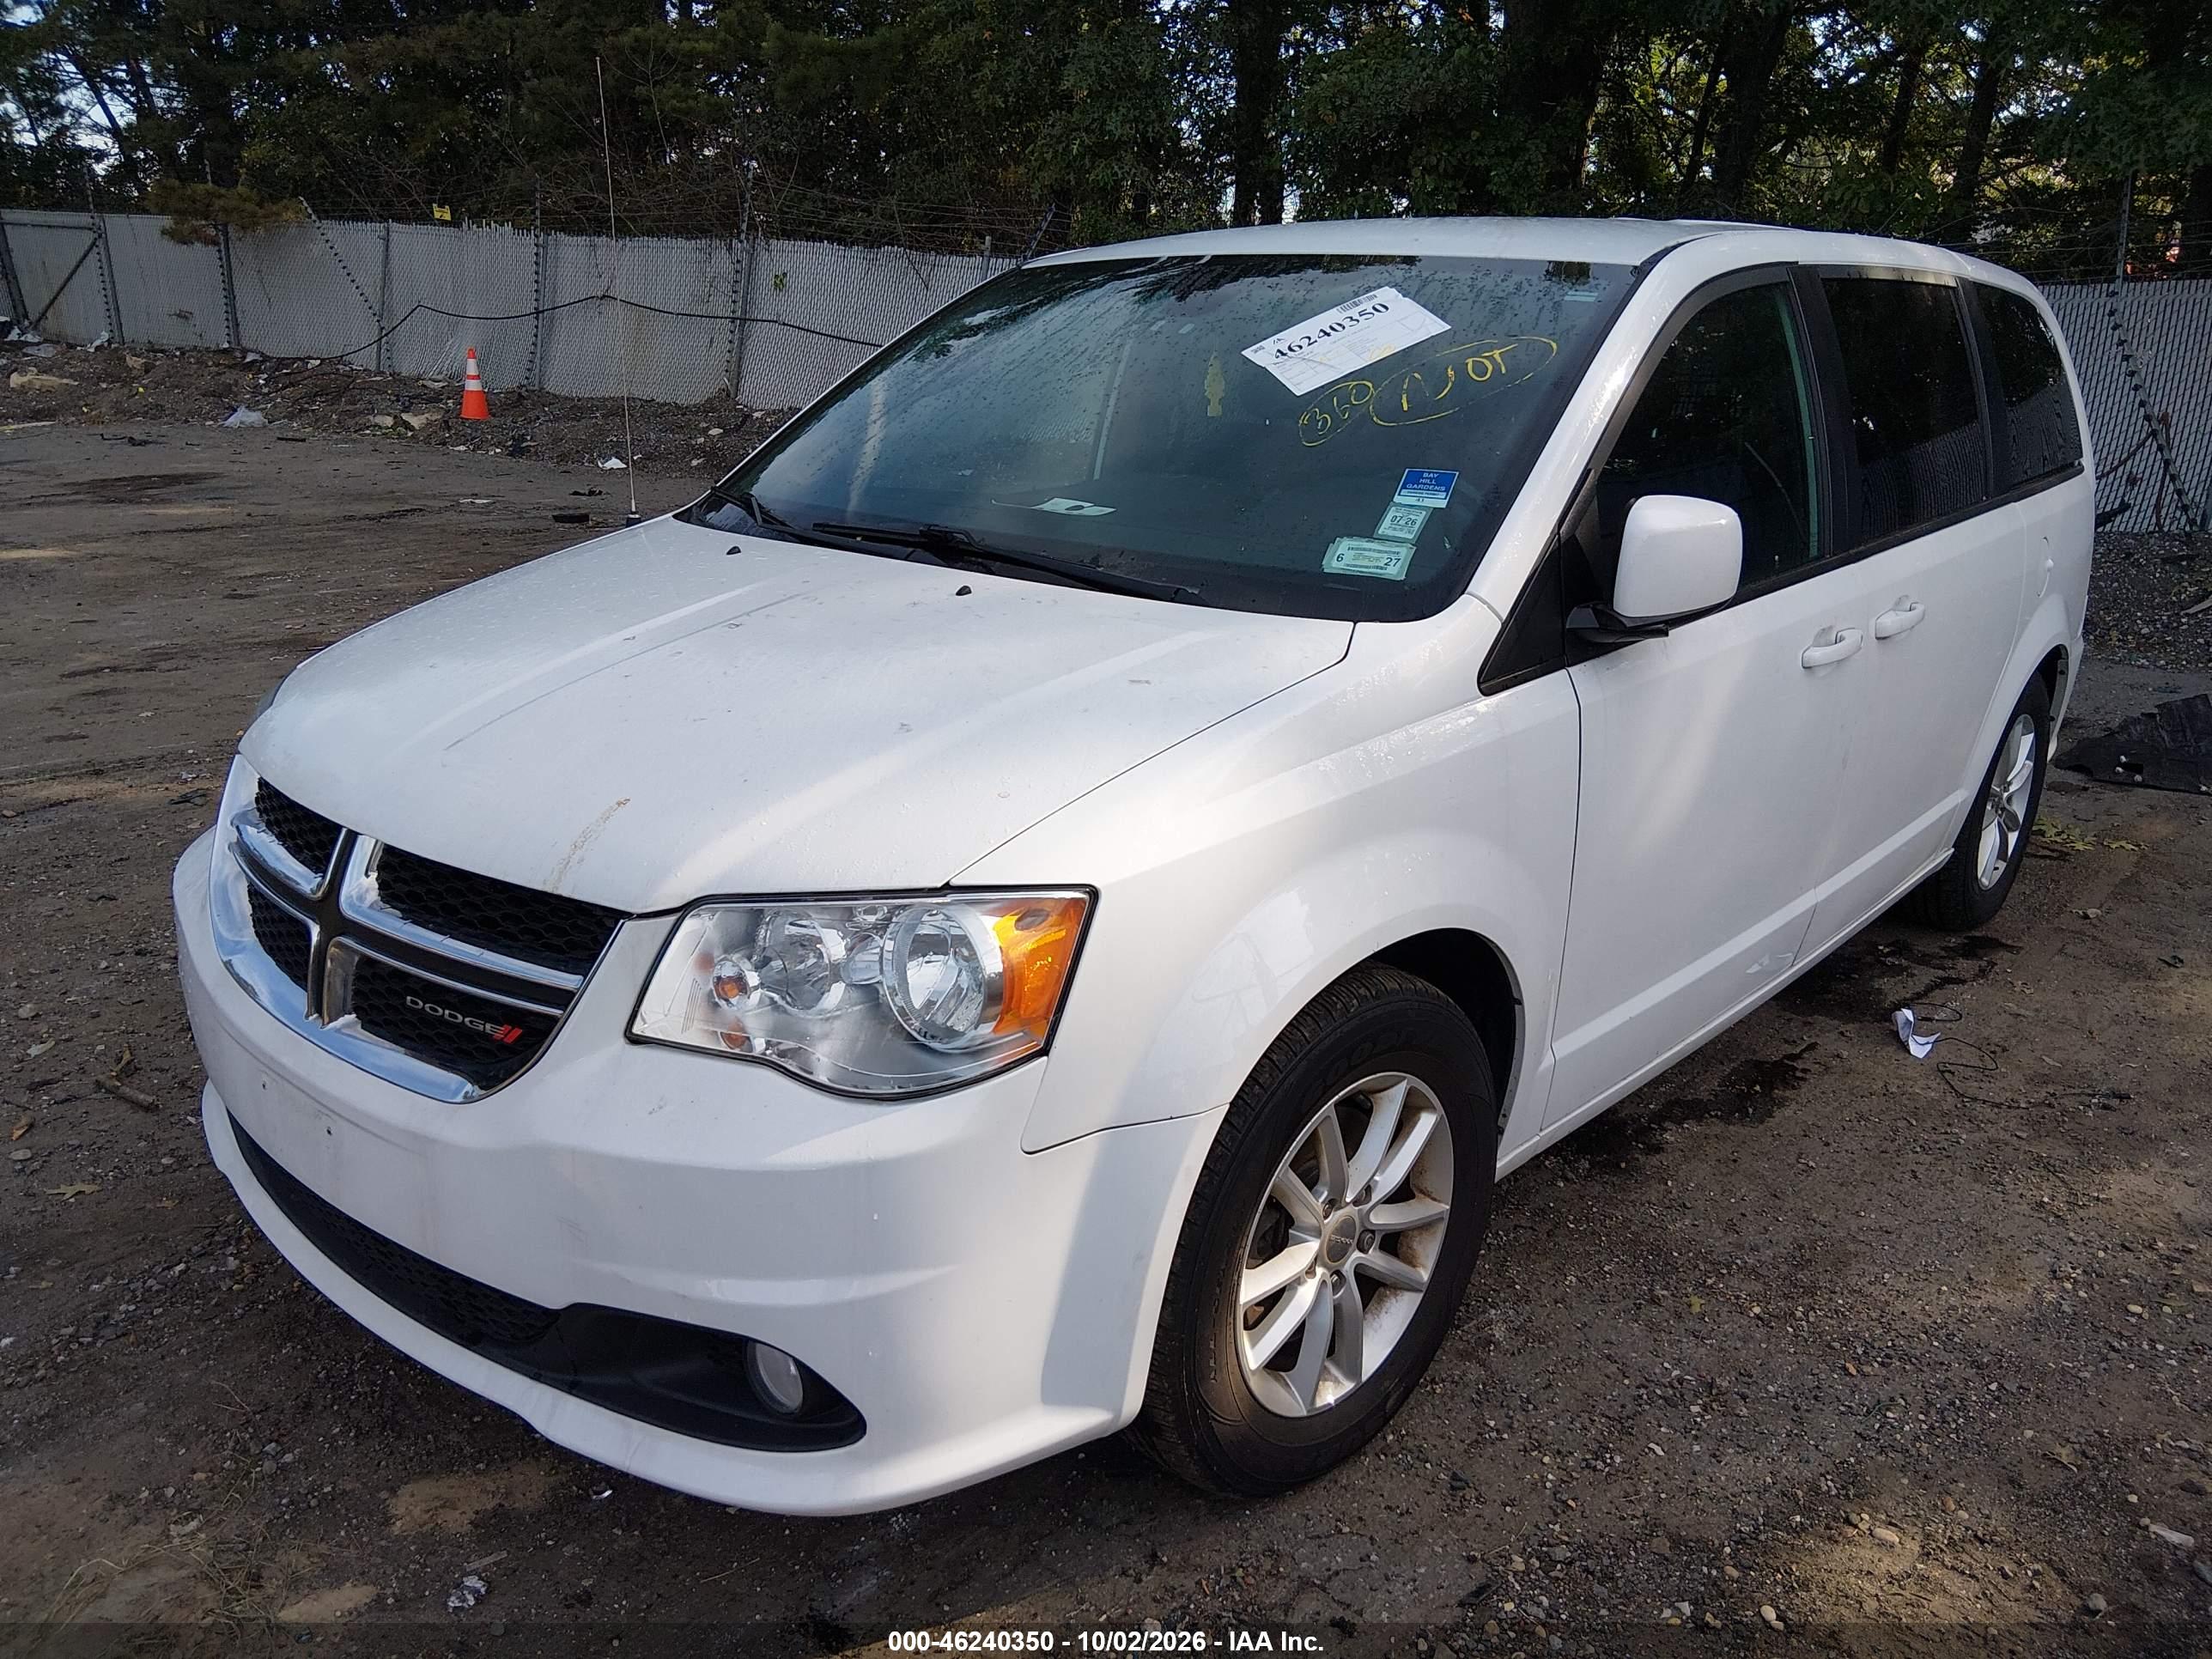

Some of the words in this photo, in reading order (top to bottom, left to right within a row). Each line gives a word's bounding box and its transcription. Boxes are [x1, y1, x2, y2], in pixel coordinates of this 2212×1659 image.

[1274, 301, 1390, 360] 46240350
[1390, 514, 1403, 524] 07
[1405, 517, 1419, 526] 26
[1336, 552, 1345, 562] 6
[1383, 556, 1401, 568] 27
[405, 995, 506, 1039] DODGE
